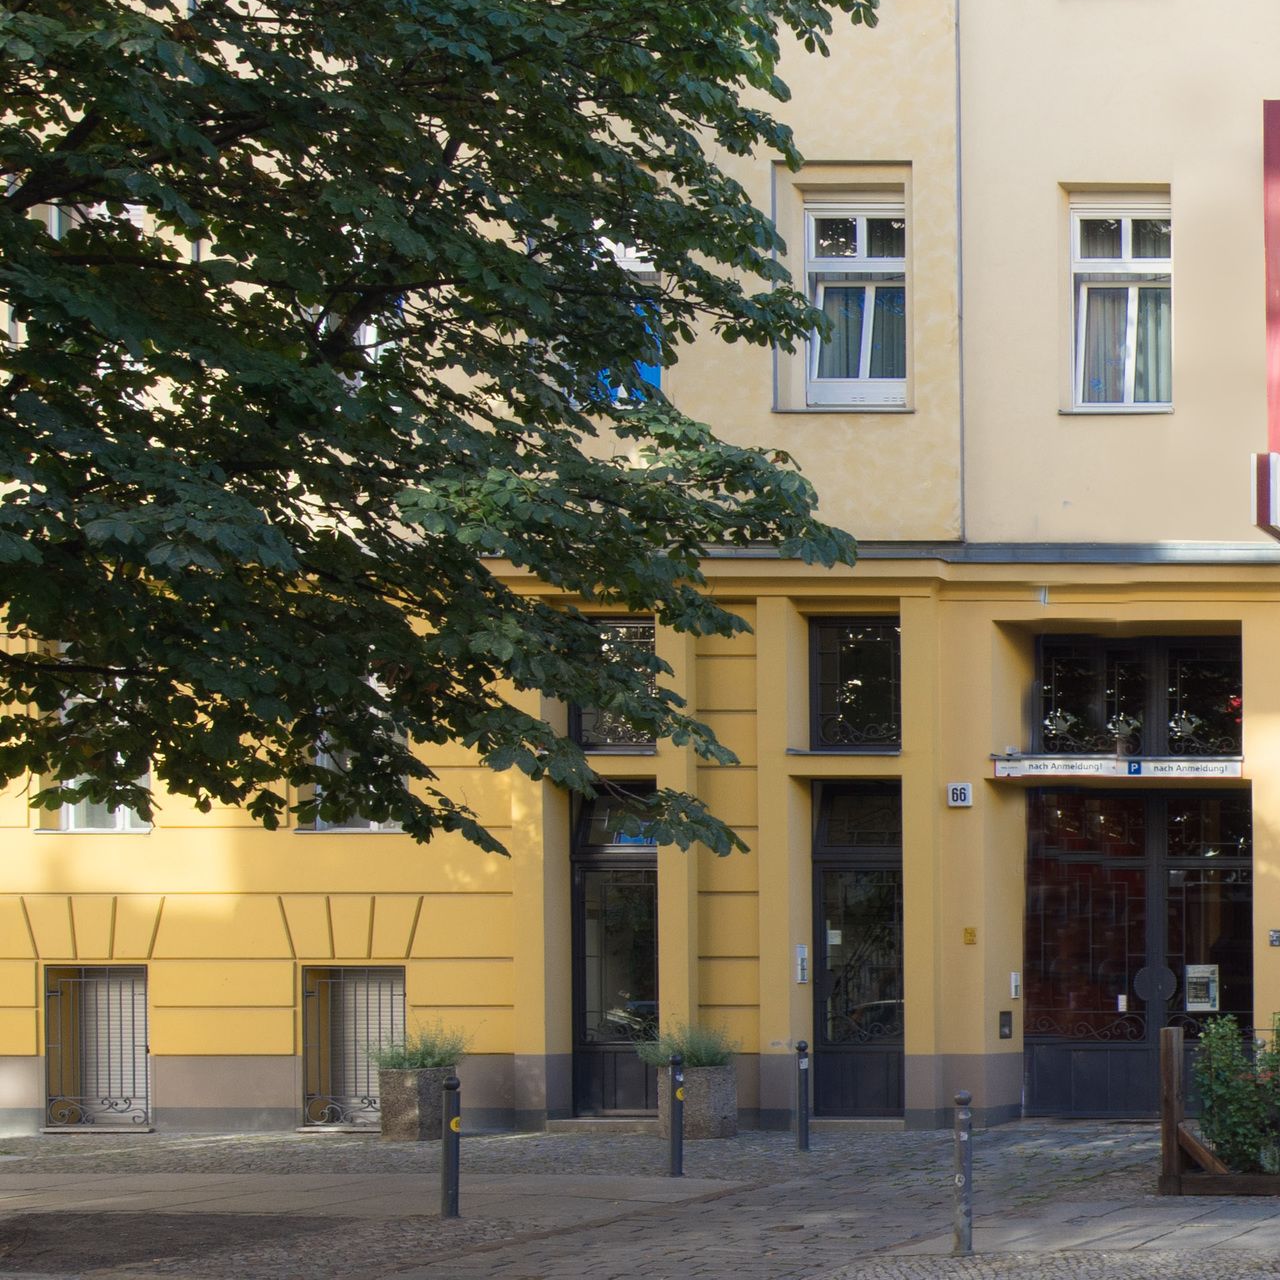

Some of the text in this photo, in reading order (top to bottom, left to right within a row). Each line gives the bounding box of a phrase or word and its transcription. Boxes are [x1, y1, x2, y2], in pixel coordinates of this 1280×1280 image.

[1131, 763, 1138, 772] P
[1153, 764, 1173, 772] nach
[951, 787, 967, 802] 66
